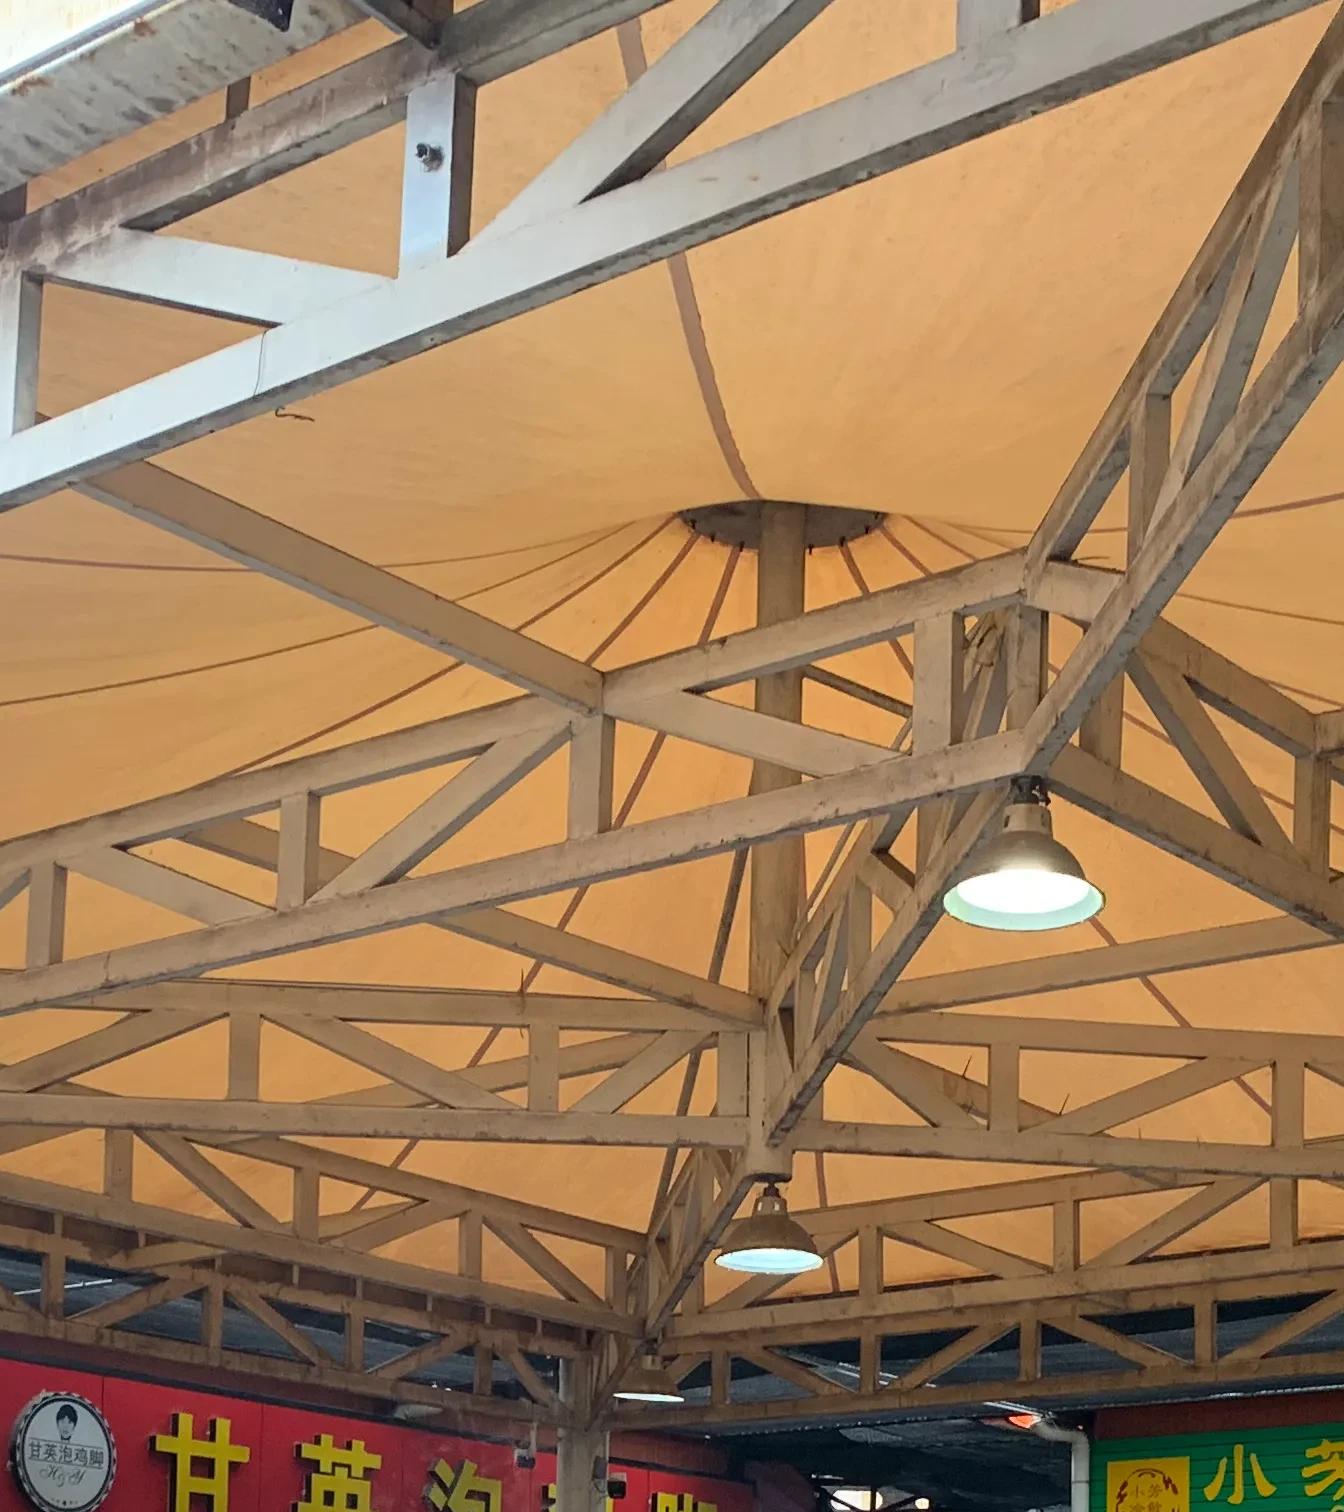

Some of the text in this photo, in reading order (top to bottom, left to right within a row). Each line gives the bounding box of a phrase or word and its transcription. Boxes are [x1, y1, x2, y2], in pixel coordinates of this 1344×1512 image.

[28, 1441, 104, 1467] 甘英泡鸡脚
